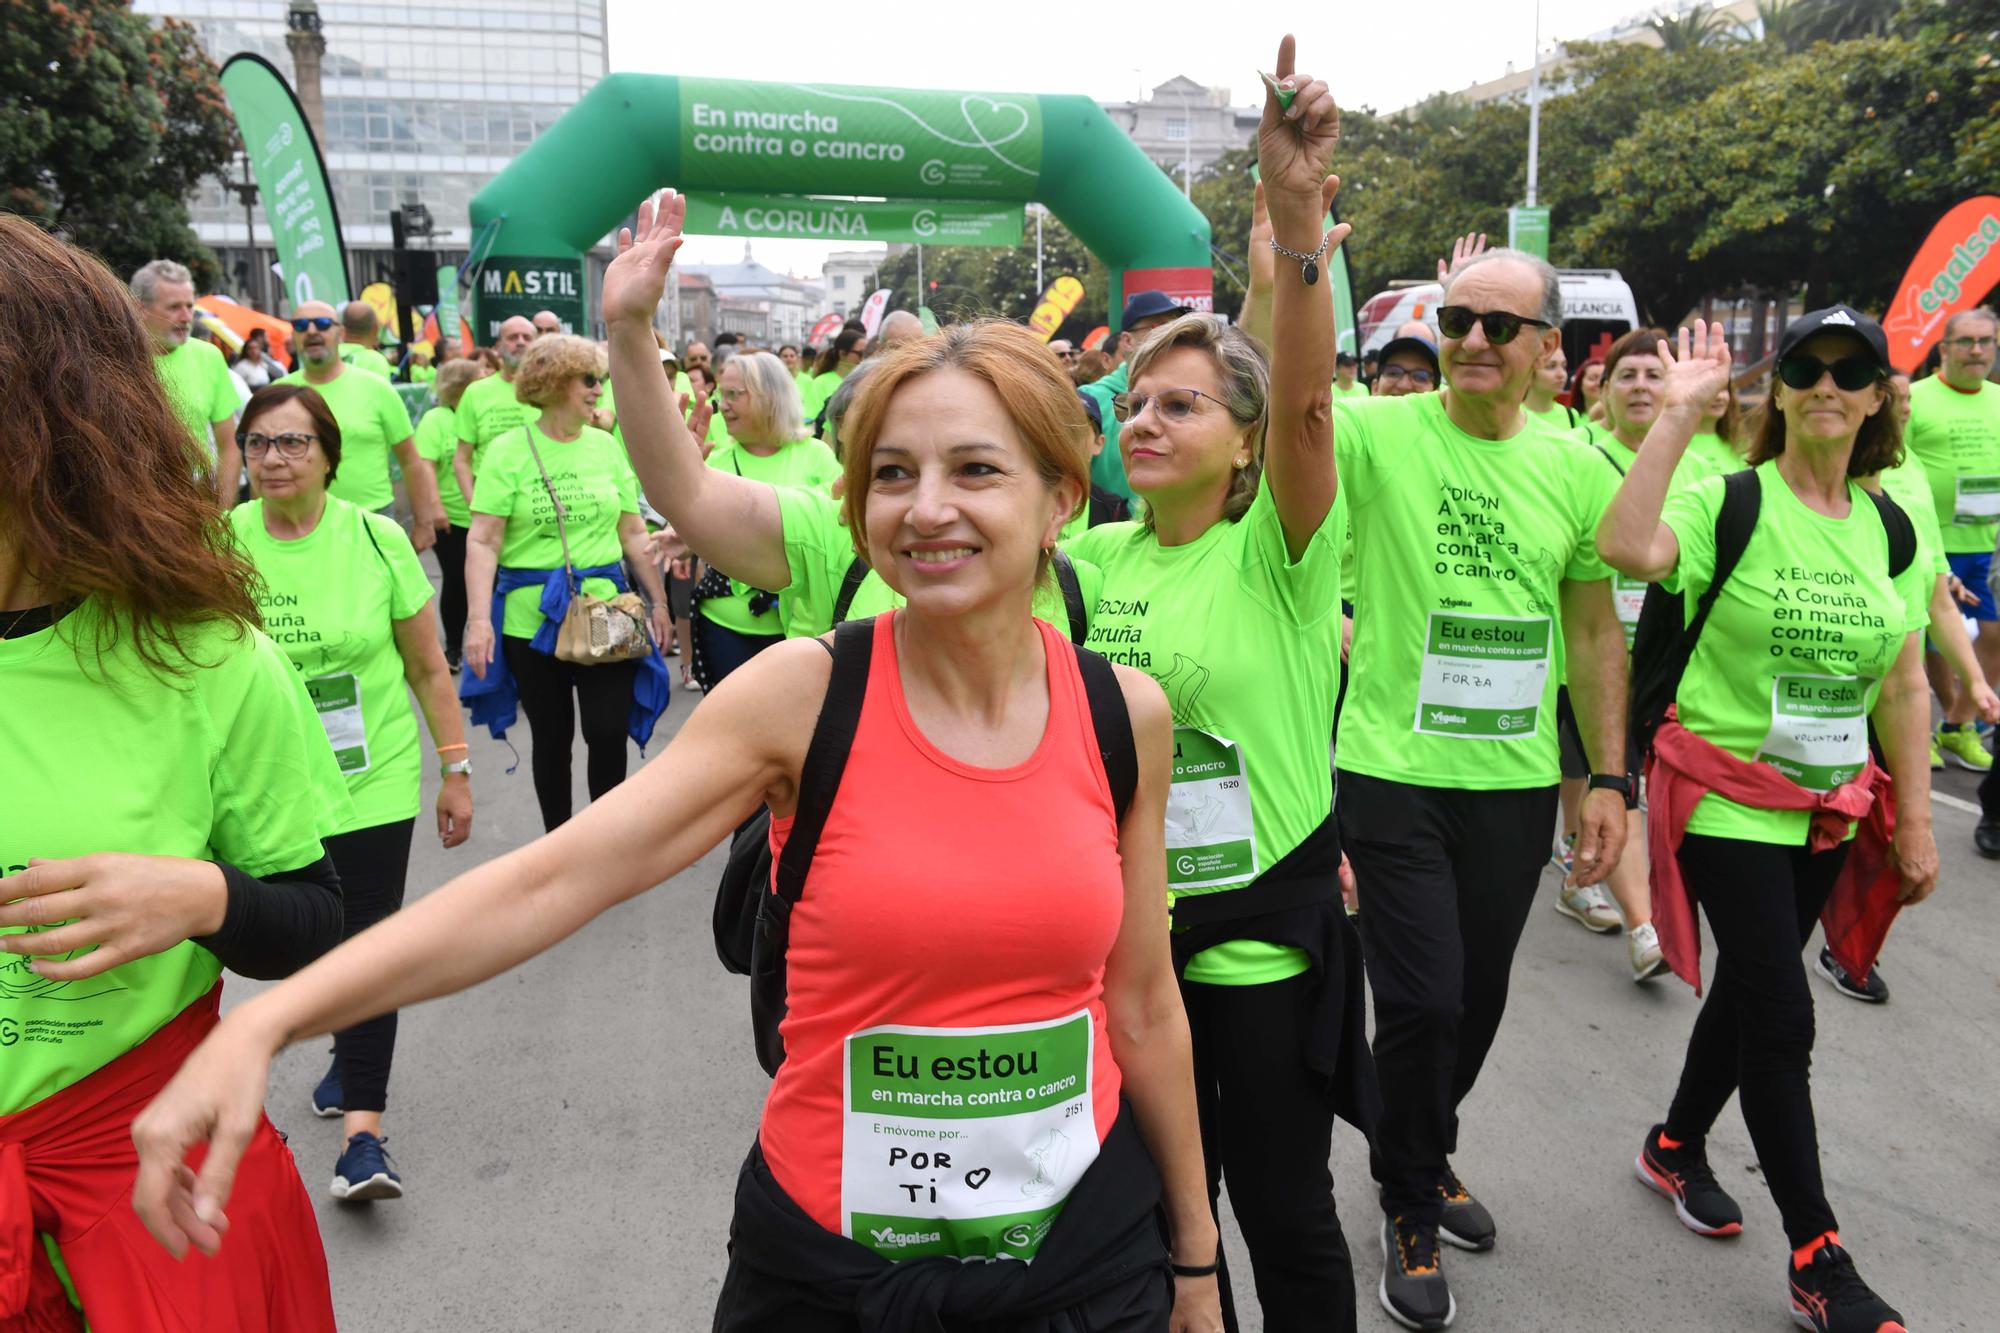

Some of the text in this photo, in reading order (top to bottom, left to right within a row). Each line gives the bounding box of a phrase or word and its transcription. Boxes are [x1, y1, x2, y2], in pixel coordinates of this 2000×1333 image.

[692, 104, 838, 134] En marcha
[693, 132, 905, 161] contra o cancro
[718, 206, 868, 236] A CORUÑA
[1888, 214, 2000, 332] Vegalsa
[483, 269, 577, 295] MASTIL
[1562, 302, 1624, 315] ULANCIA
[542, 485, 584, 493] Cruña
[532, 493, 595, 504] en archa
[532, 504, 572, 515] cona
[1438, 499, 1452, 516] A
[534, 518, 542, 526] o
[1437, 522, 1462, 537] en
[1436, 542, 1492, 563] conta
[1435, 561, 1448, 574] o
[1774, 568, 1786, 581] X
[259, 592, 298, 607] CIÓN
[1774, 587, 1868, 609] A Coruña
[263, 613, 305, 627] uña
[1774, 607, 1885, 629] en marcha
[266, 629, 322, 643] archa
[1440, 622, 1526, 643] Eu estou
[1772, 626, 1844, 644] contra
[1438, 643, 1451, 651] en
[1452, 643, 1486, 654] marcha
[1487, 646, 1515, 655] contra
[1770, 644, 1859, 663] o cancro
[1100, 647, 1152, 668] archa
[1442, 672, 1493, 688] FORZA
[1787, 682, 1812, 699] Eu
[1176, 760, 1226, 775] o cancro
[1219, 780, 1239, 789] 1520
[25, 1019, 104, 1028] asociación española
[36, 1035, 63, 1044] Coruña
[873, 1045, 1038, 1081] Eu estou
[871, 1075, 1076, 1106] en marcha contra o cancro
[1065, 1102, 1083, 1118] 2151
[874, 1124, 880, 1133] E
[883, 1124, 936, 1138] móvome
[889, 1147, 951, 1170] POR
[870, 1227, 941, 1247] Vegalsa
